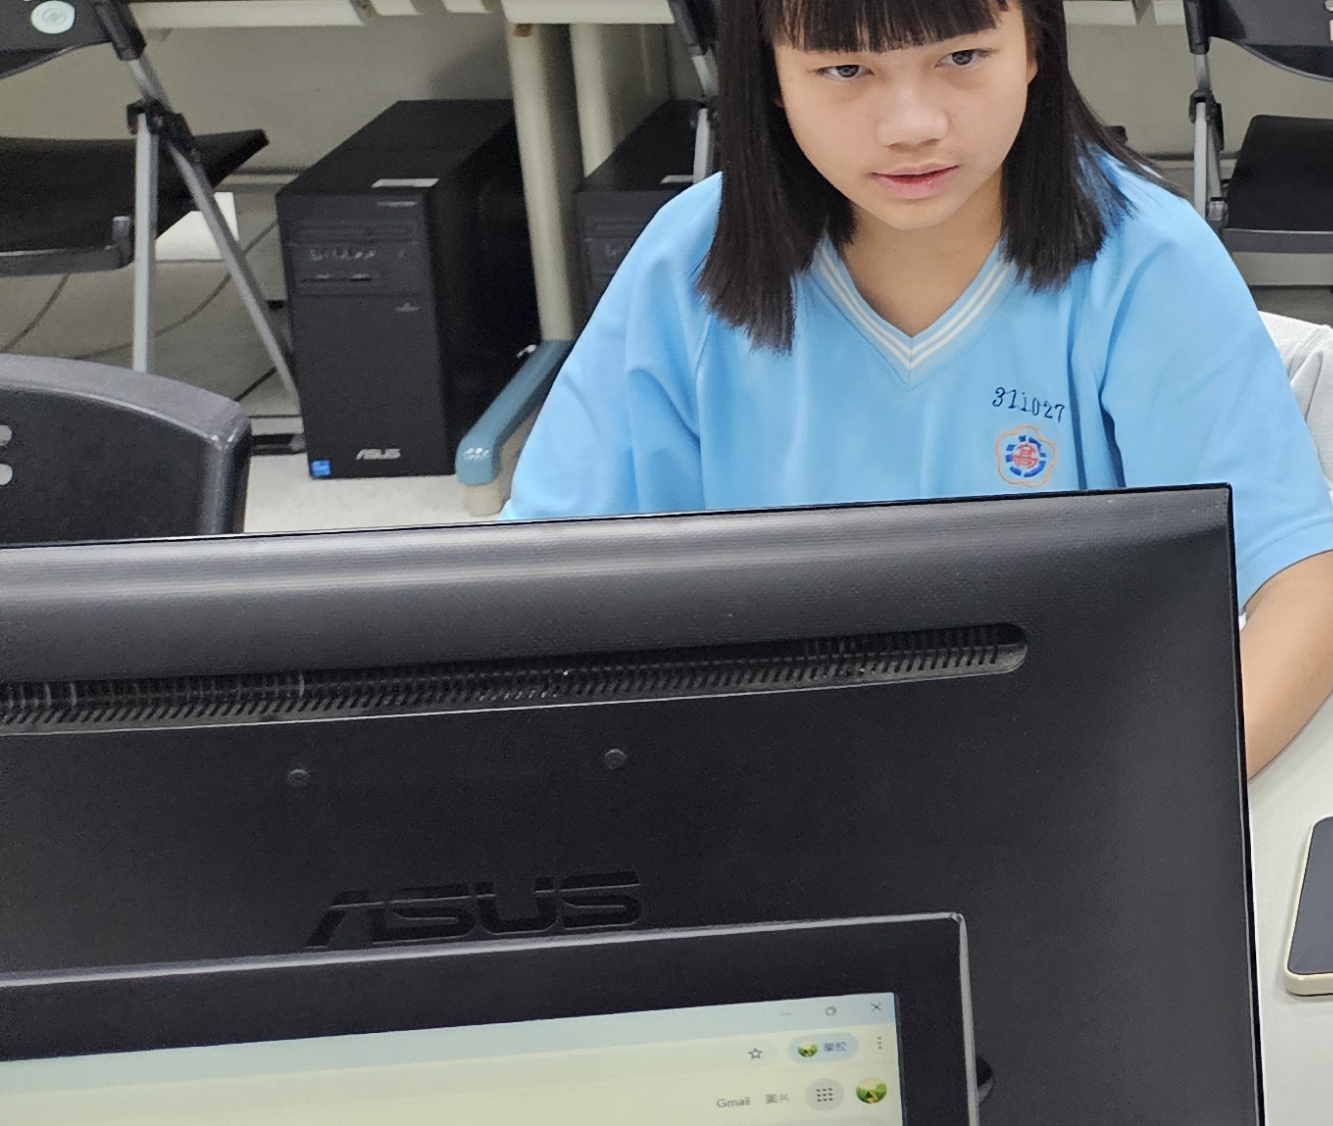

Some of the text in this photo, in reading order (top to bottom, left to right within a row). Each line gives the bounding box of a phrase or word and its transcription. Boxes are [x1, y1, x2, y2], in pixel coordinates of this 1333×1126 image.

[355, 448, 401, 460] ASUS
[305, 871, 643, 949] ASUS
[715, 1095, 752, 1109] Gmail
